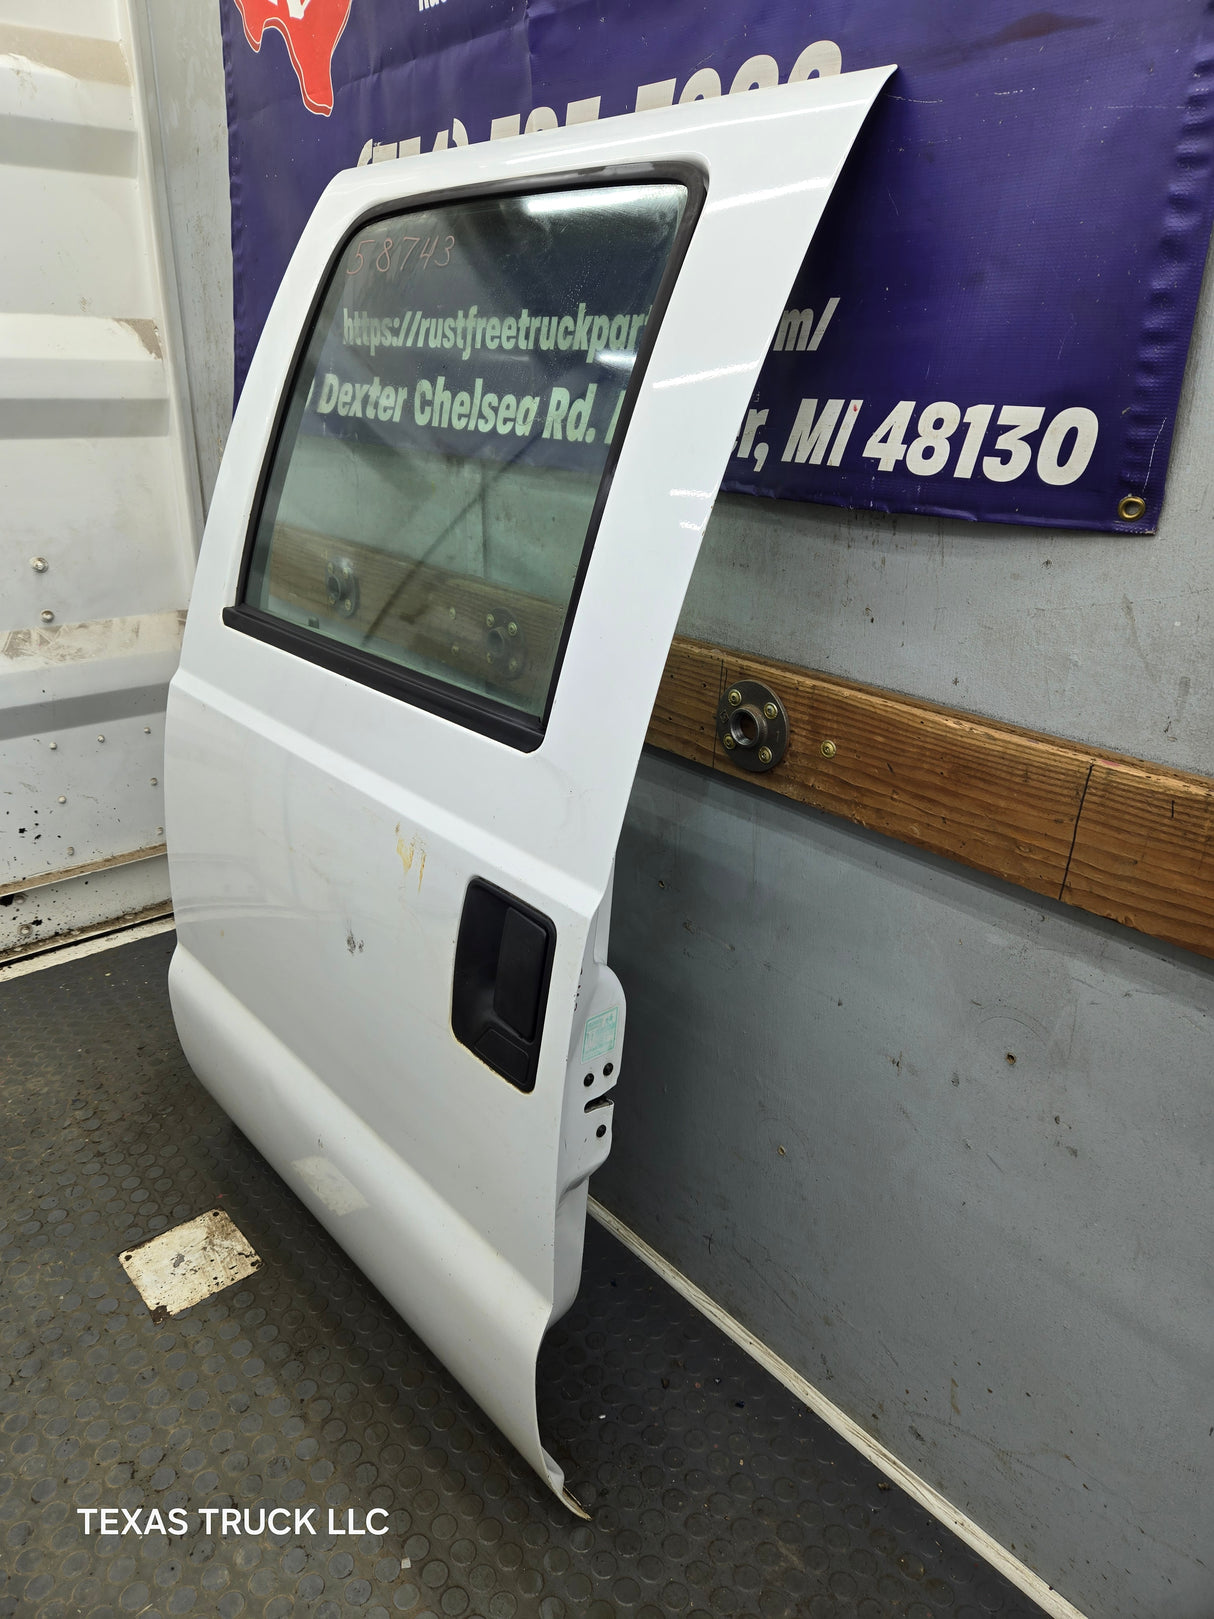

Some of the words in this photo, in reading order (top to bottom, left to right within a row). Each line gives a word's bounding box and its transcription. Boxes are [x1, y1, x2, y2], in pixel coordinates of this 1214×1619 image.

[347, 235, 455, 275] 58743
[317, 373, 408, 423] Dexter
[414, 375, 540, 437] Chelsea
[541, 383, 597, 444] Rd.
[781, 398, 864, 467] MI
[862, 400, 1099, 486] 48130
